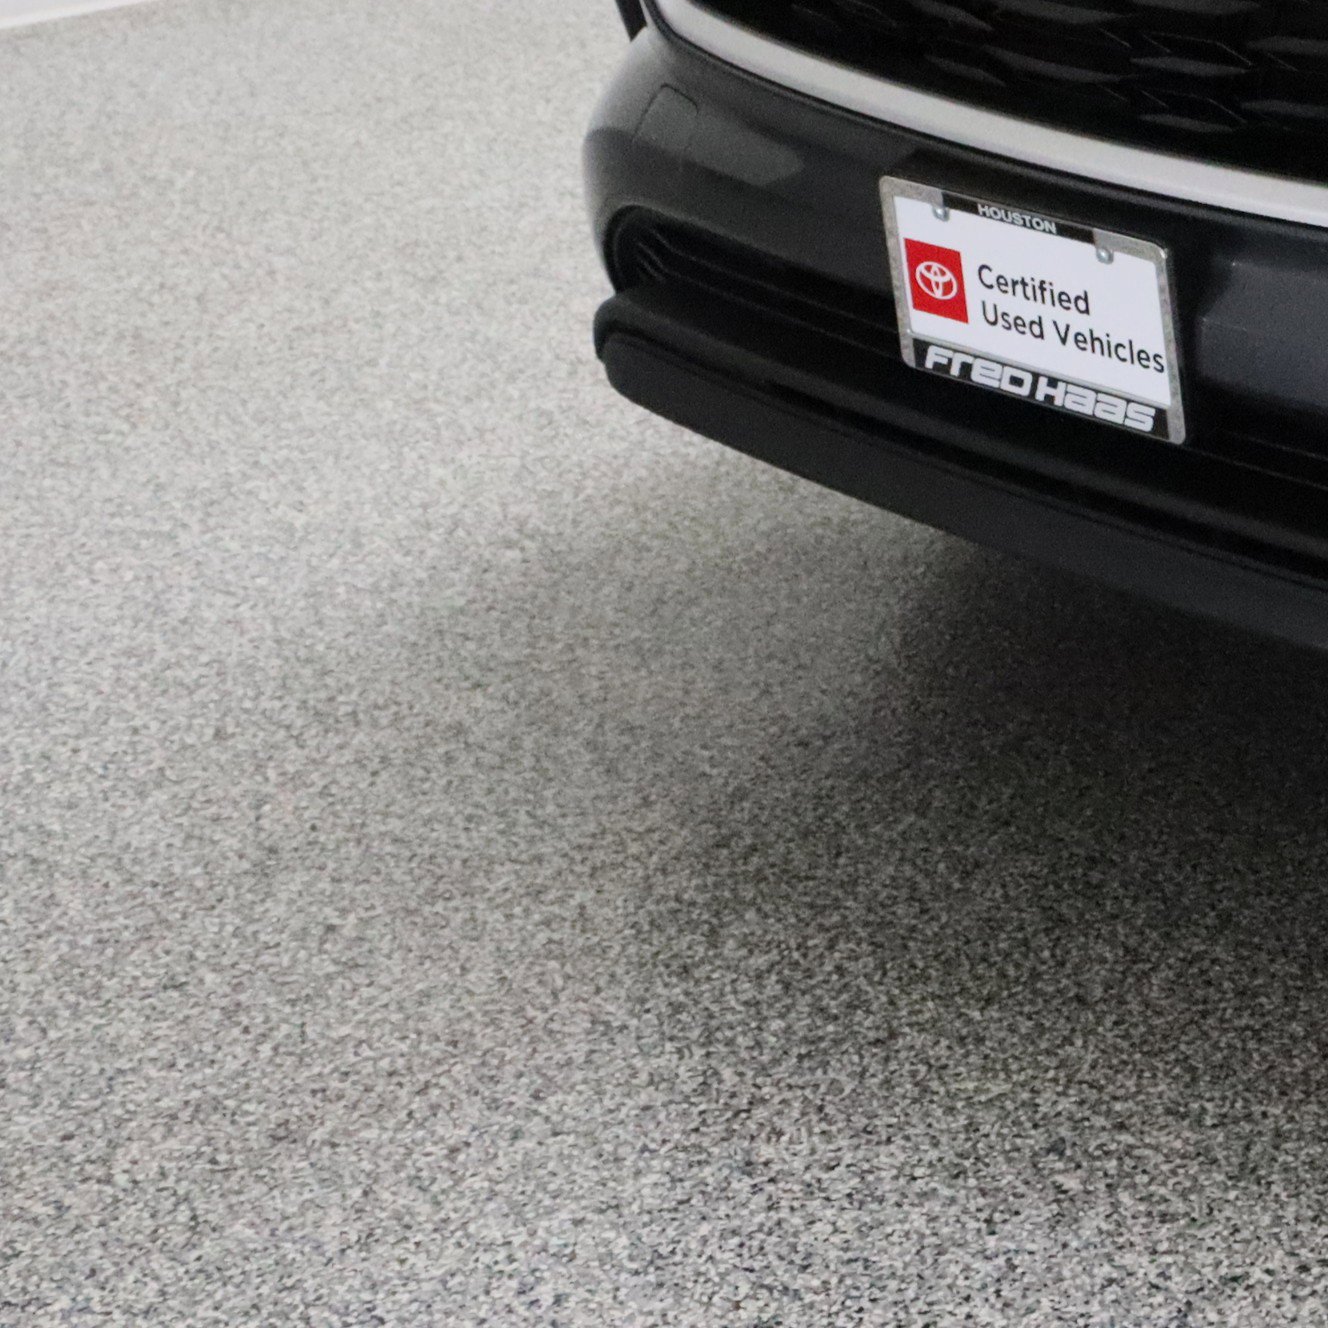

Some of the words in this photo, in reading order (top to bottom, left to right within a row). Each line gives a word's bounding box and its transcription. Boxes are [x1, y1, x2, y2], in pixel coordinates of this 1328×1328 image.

[977, 203, 1057, 234] HOUSTON
[978, 264, 1091, 316] Certified
[981, 301, 1044, 340] Used
[1053, 320, 1165, 374] Vehicles
